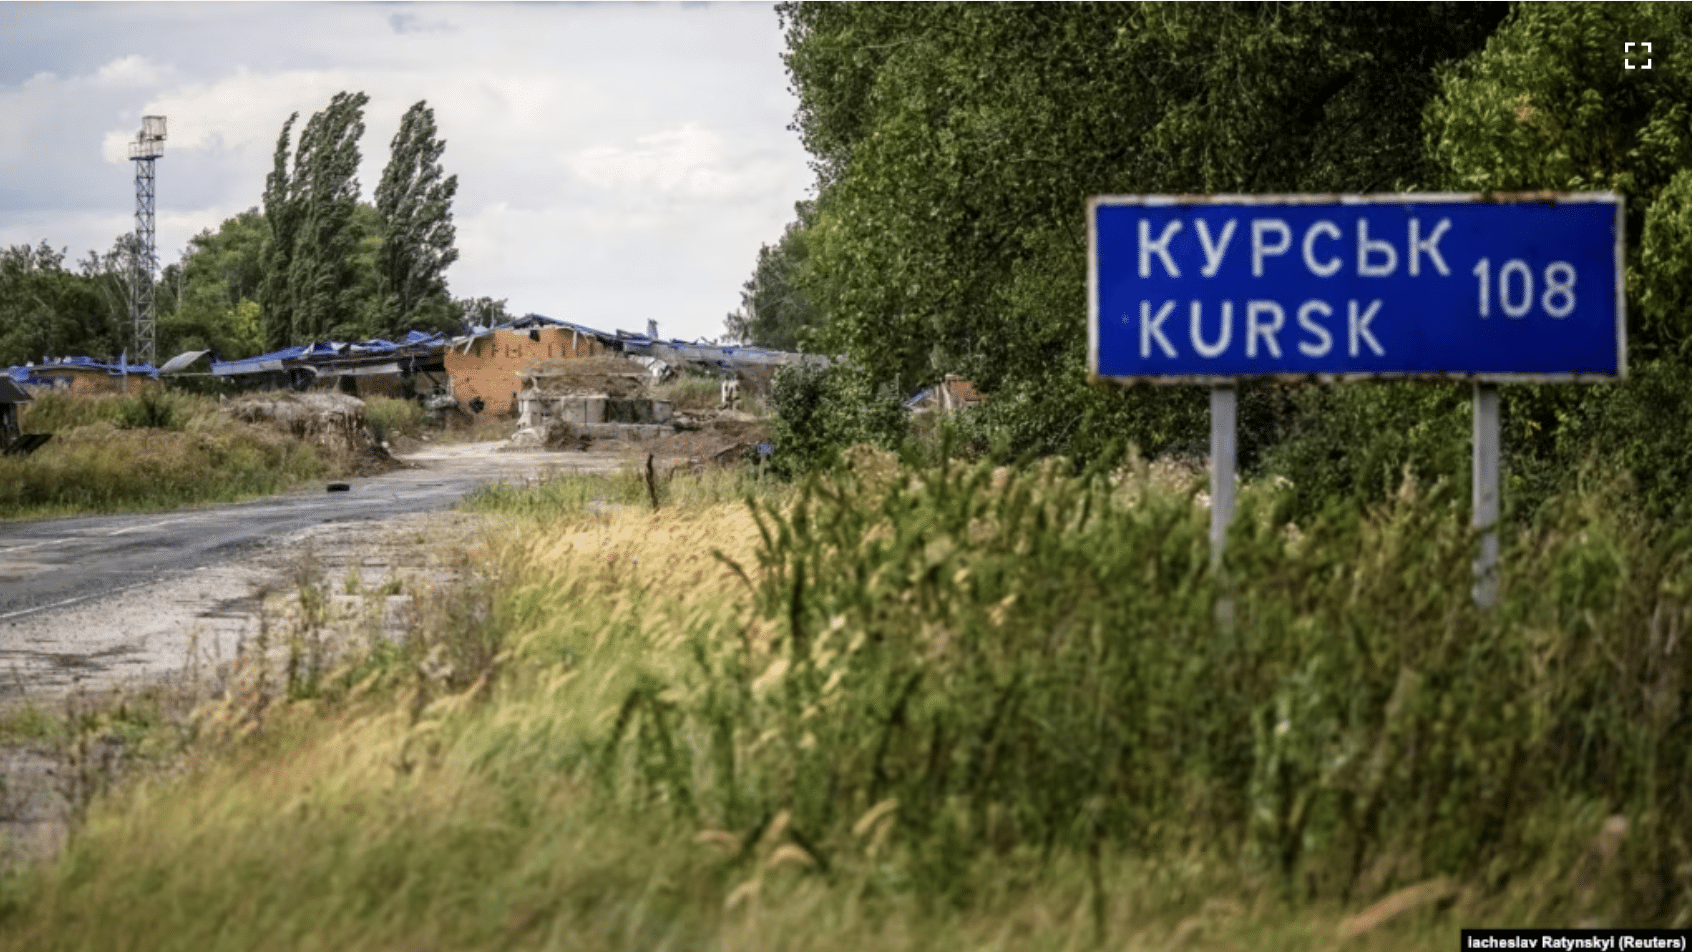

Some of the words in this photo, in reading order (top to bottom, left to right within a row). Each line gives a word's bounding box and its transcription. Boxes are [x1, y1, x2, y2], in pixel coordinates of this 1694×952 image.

[1138, 218, 1451, 279] КУРСЬК
[1473, 258, 1576, 318] 108
[1139, 299, 1384, 358] KURSK
